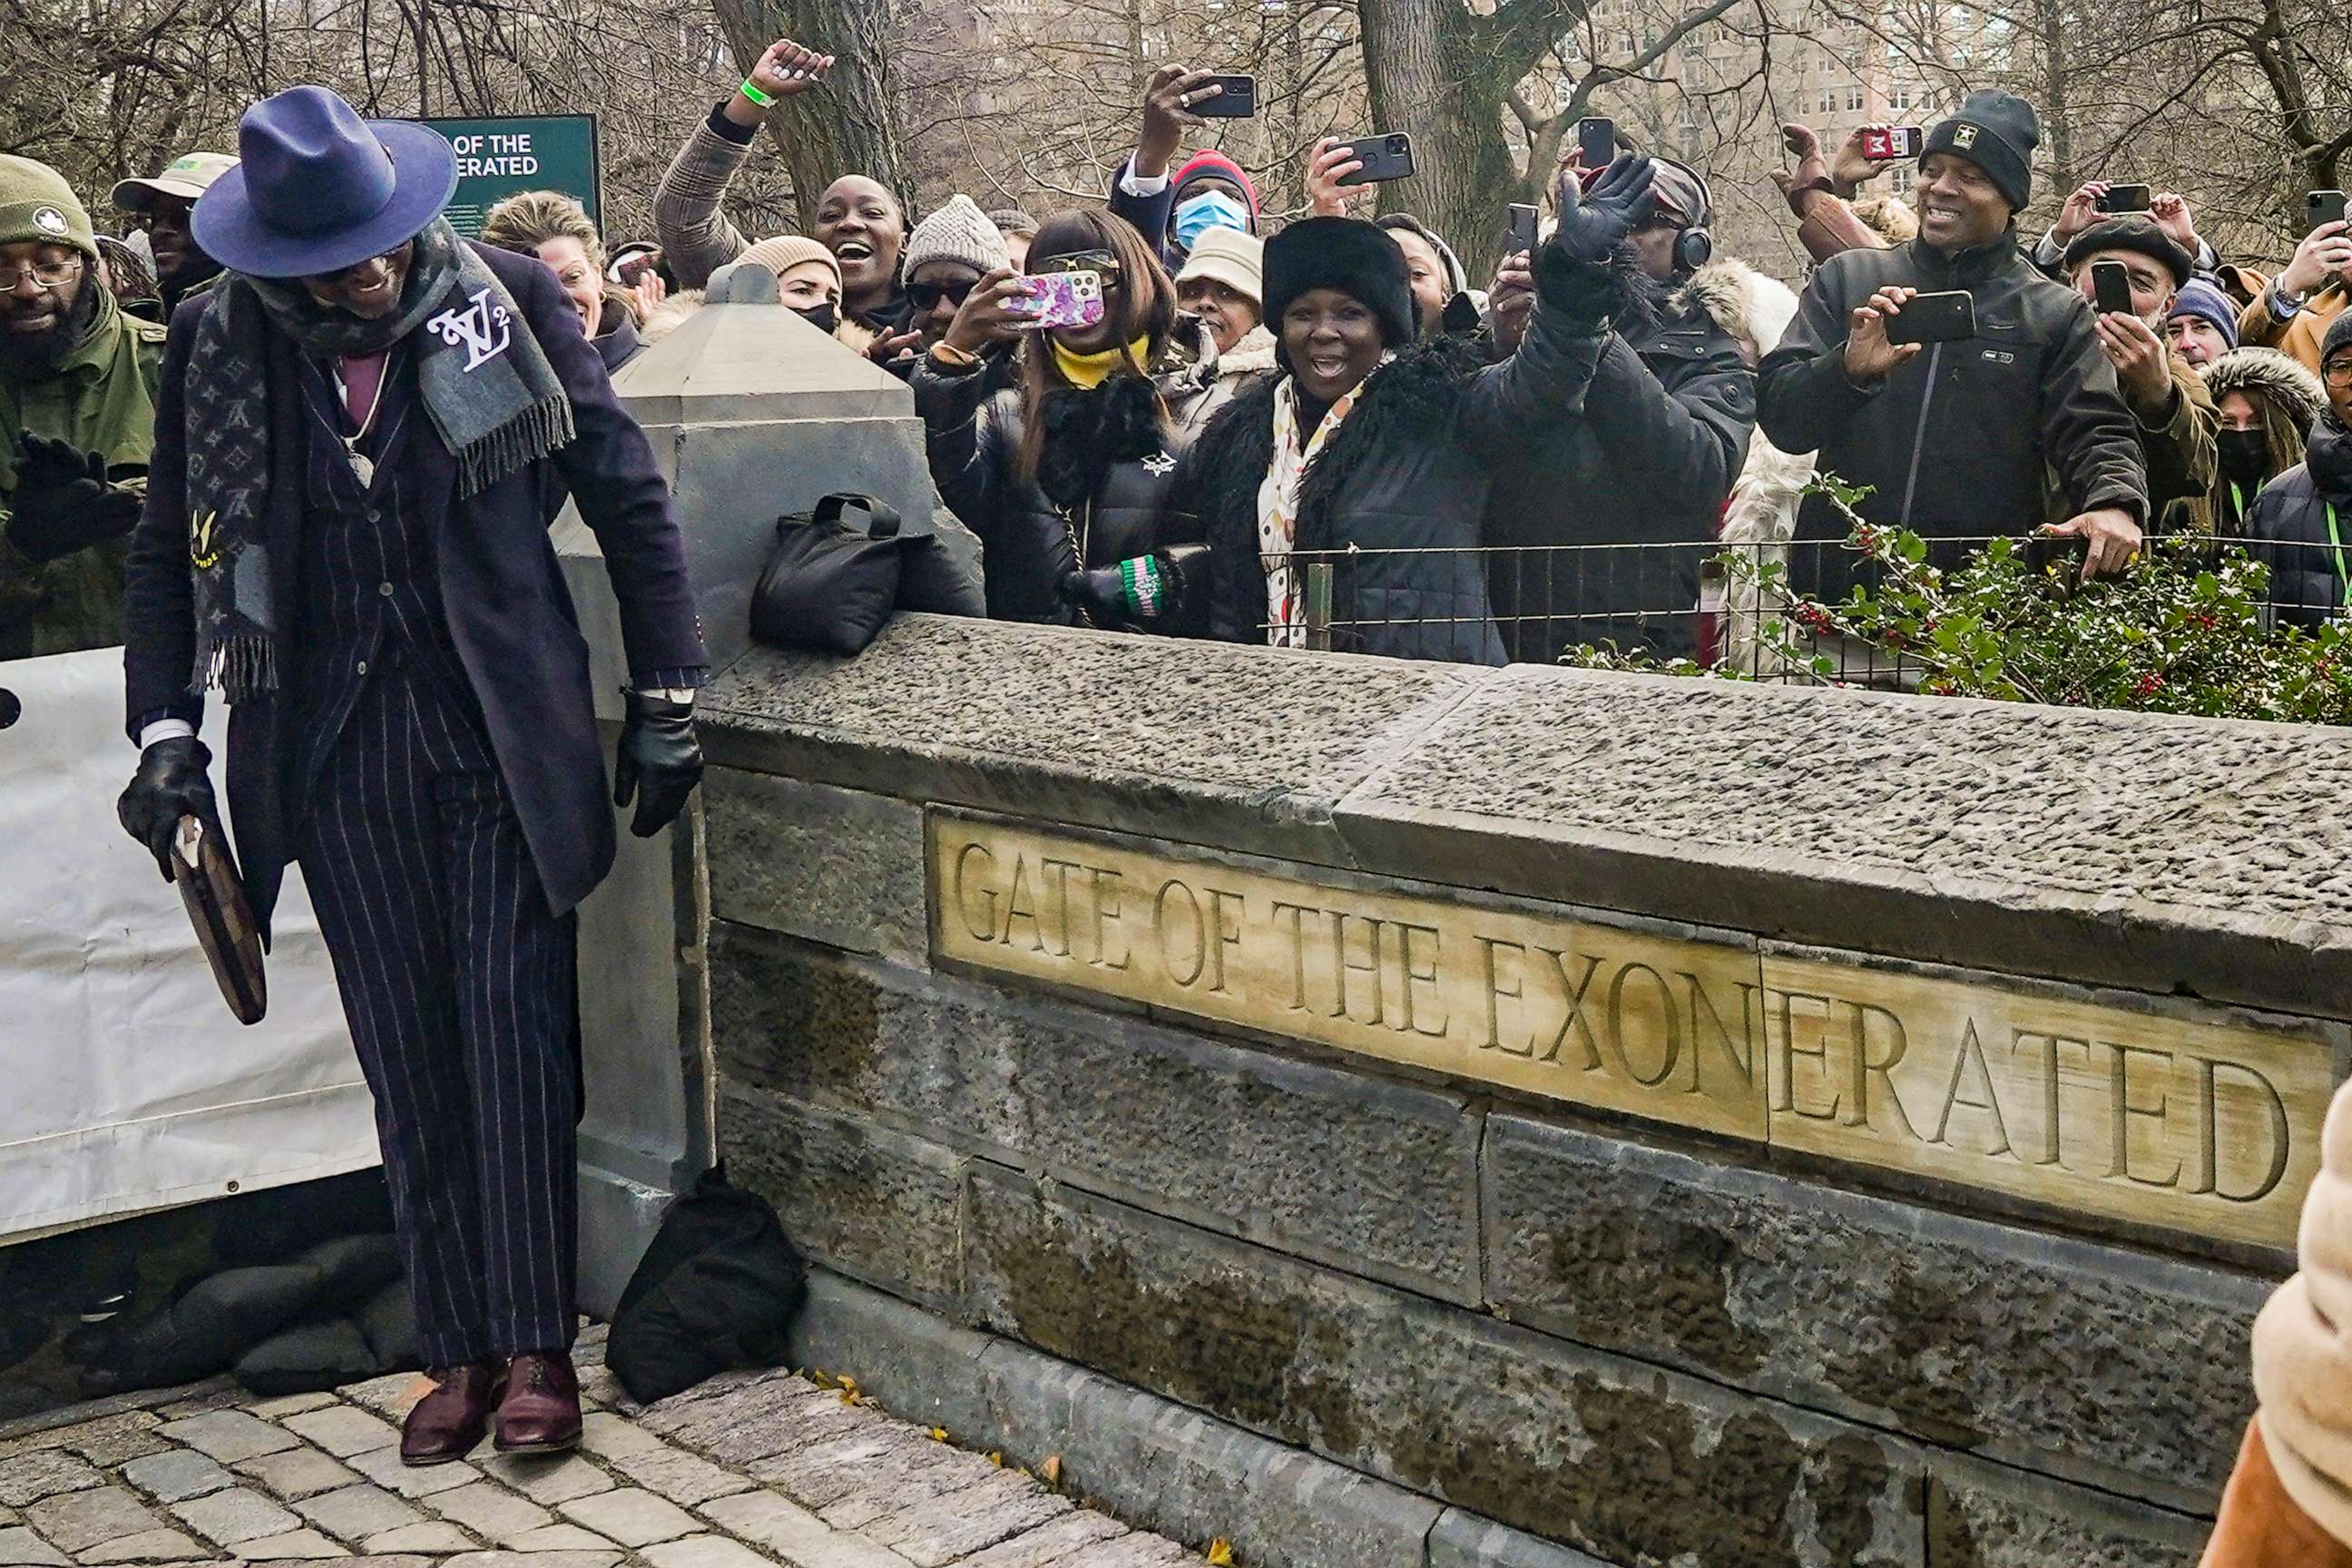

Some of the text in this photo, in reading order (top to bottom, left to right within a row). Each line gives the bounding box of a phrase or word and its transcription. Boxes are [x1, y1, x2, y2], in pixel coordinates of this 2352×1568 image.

[454, 134, 532, 154] OF THE
[955, 842, 2290, 1203] GATE OF THE EXONERATED
